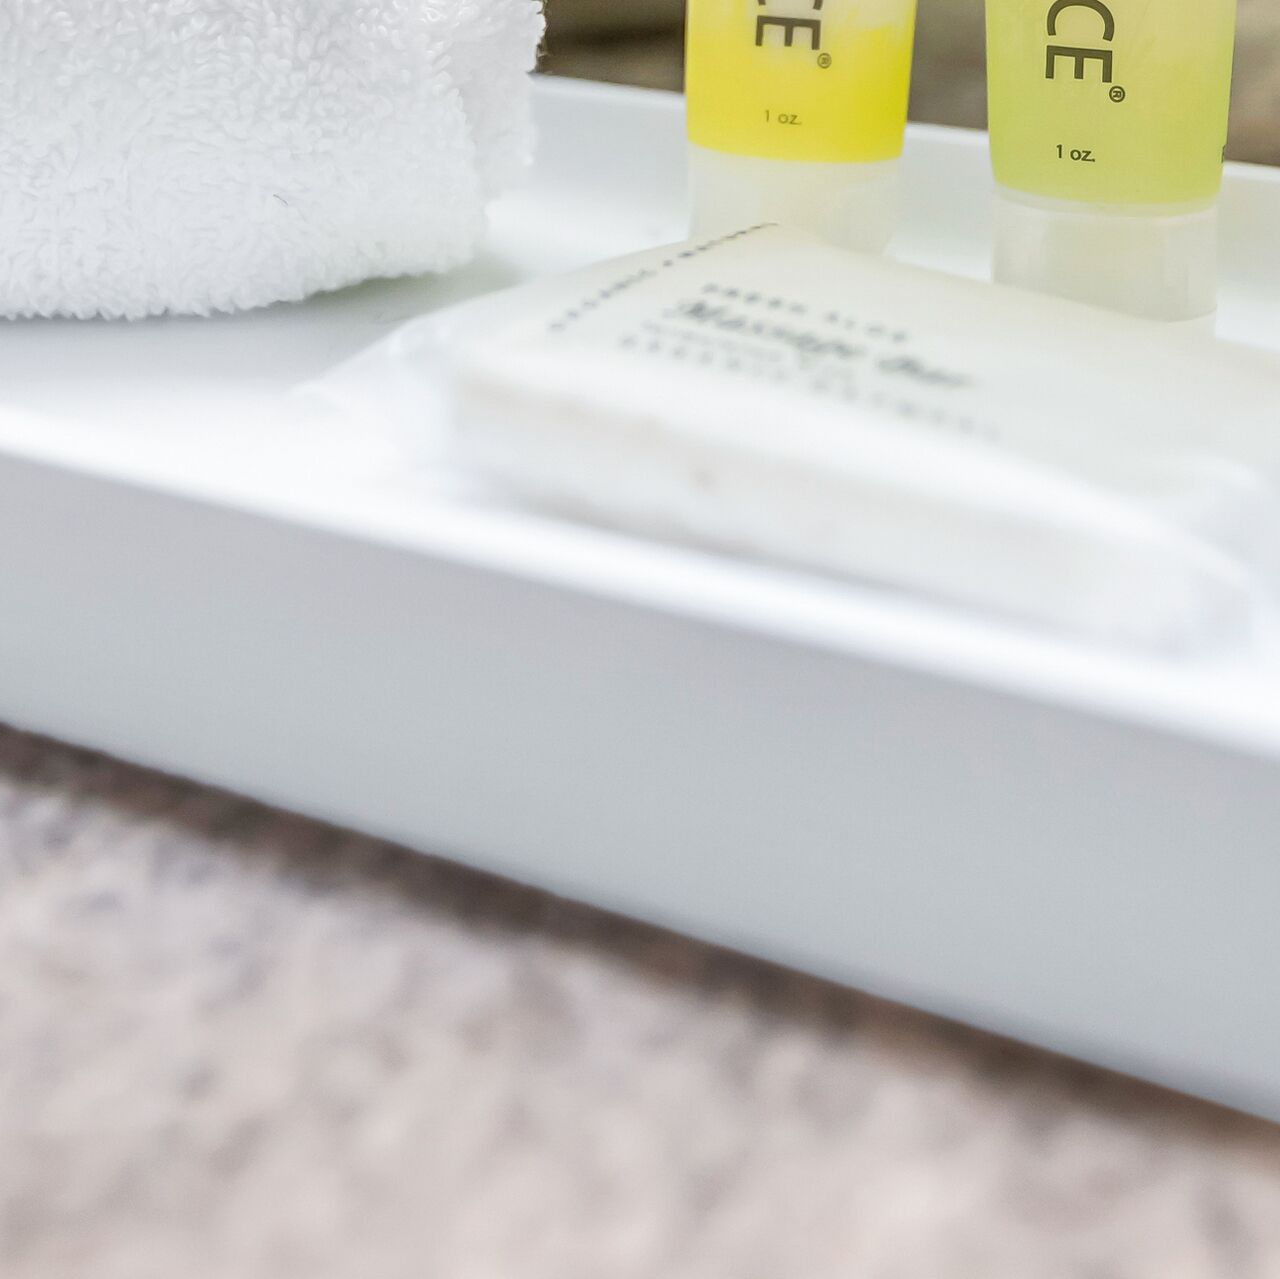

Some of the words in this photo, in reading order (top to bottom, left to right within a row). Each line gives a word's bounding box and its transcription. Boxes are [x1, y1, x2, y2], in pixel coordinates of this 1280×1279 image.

[764, 109, 770, 123] 1
[1056, 144, 1062, 159] 1
[1069, 149, 1096, 162] oz.
